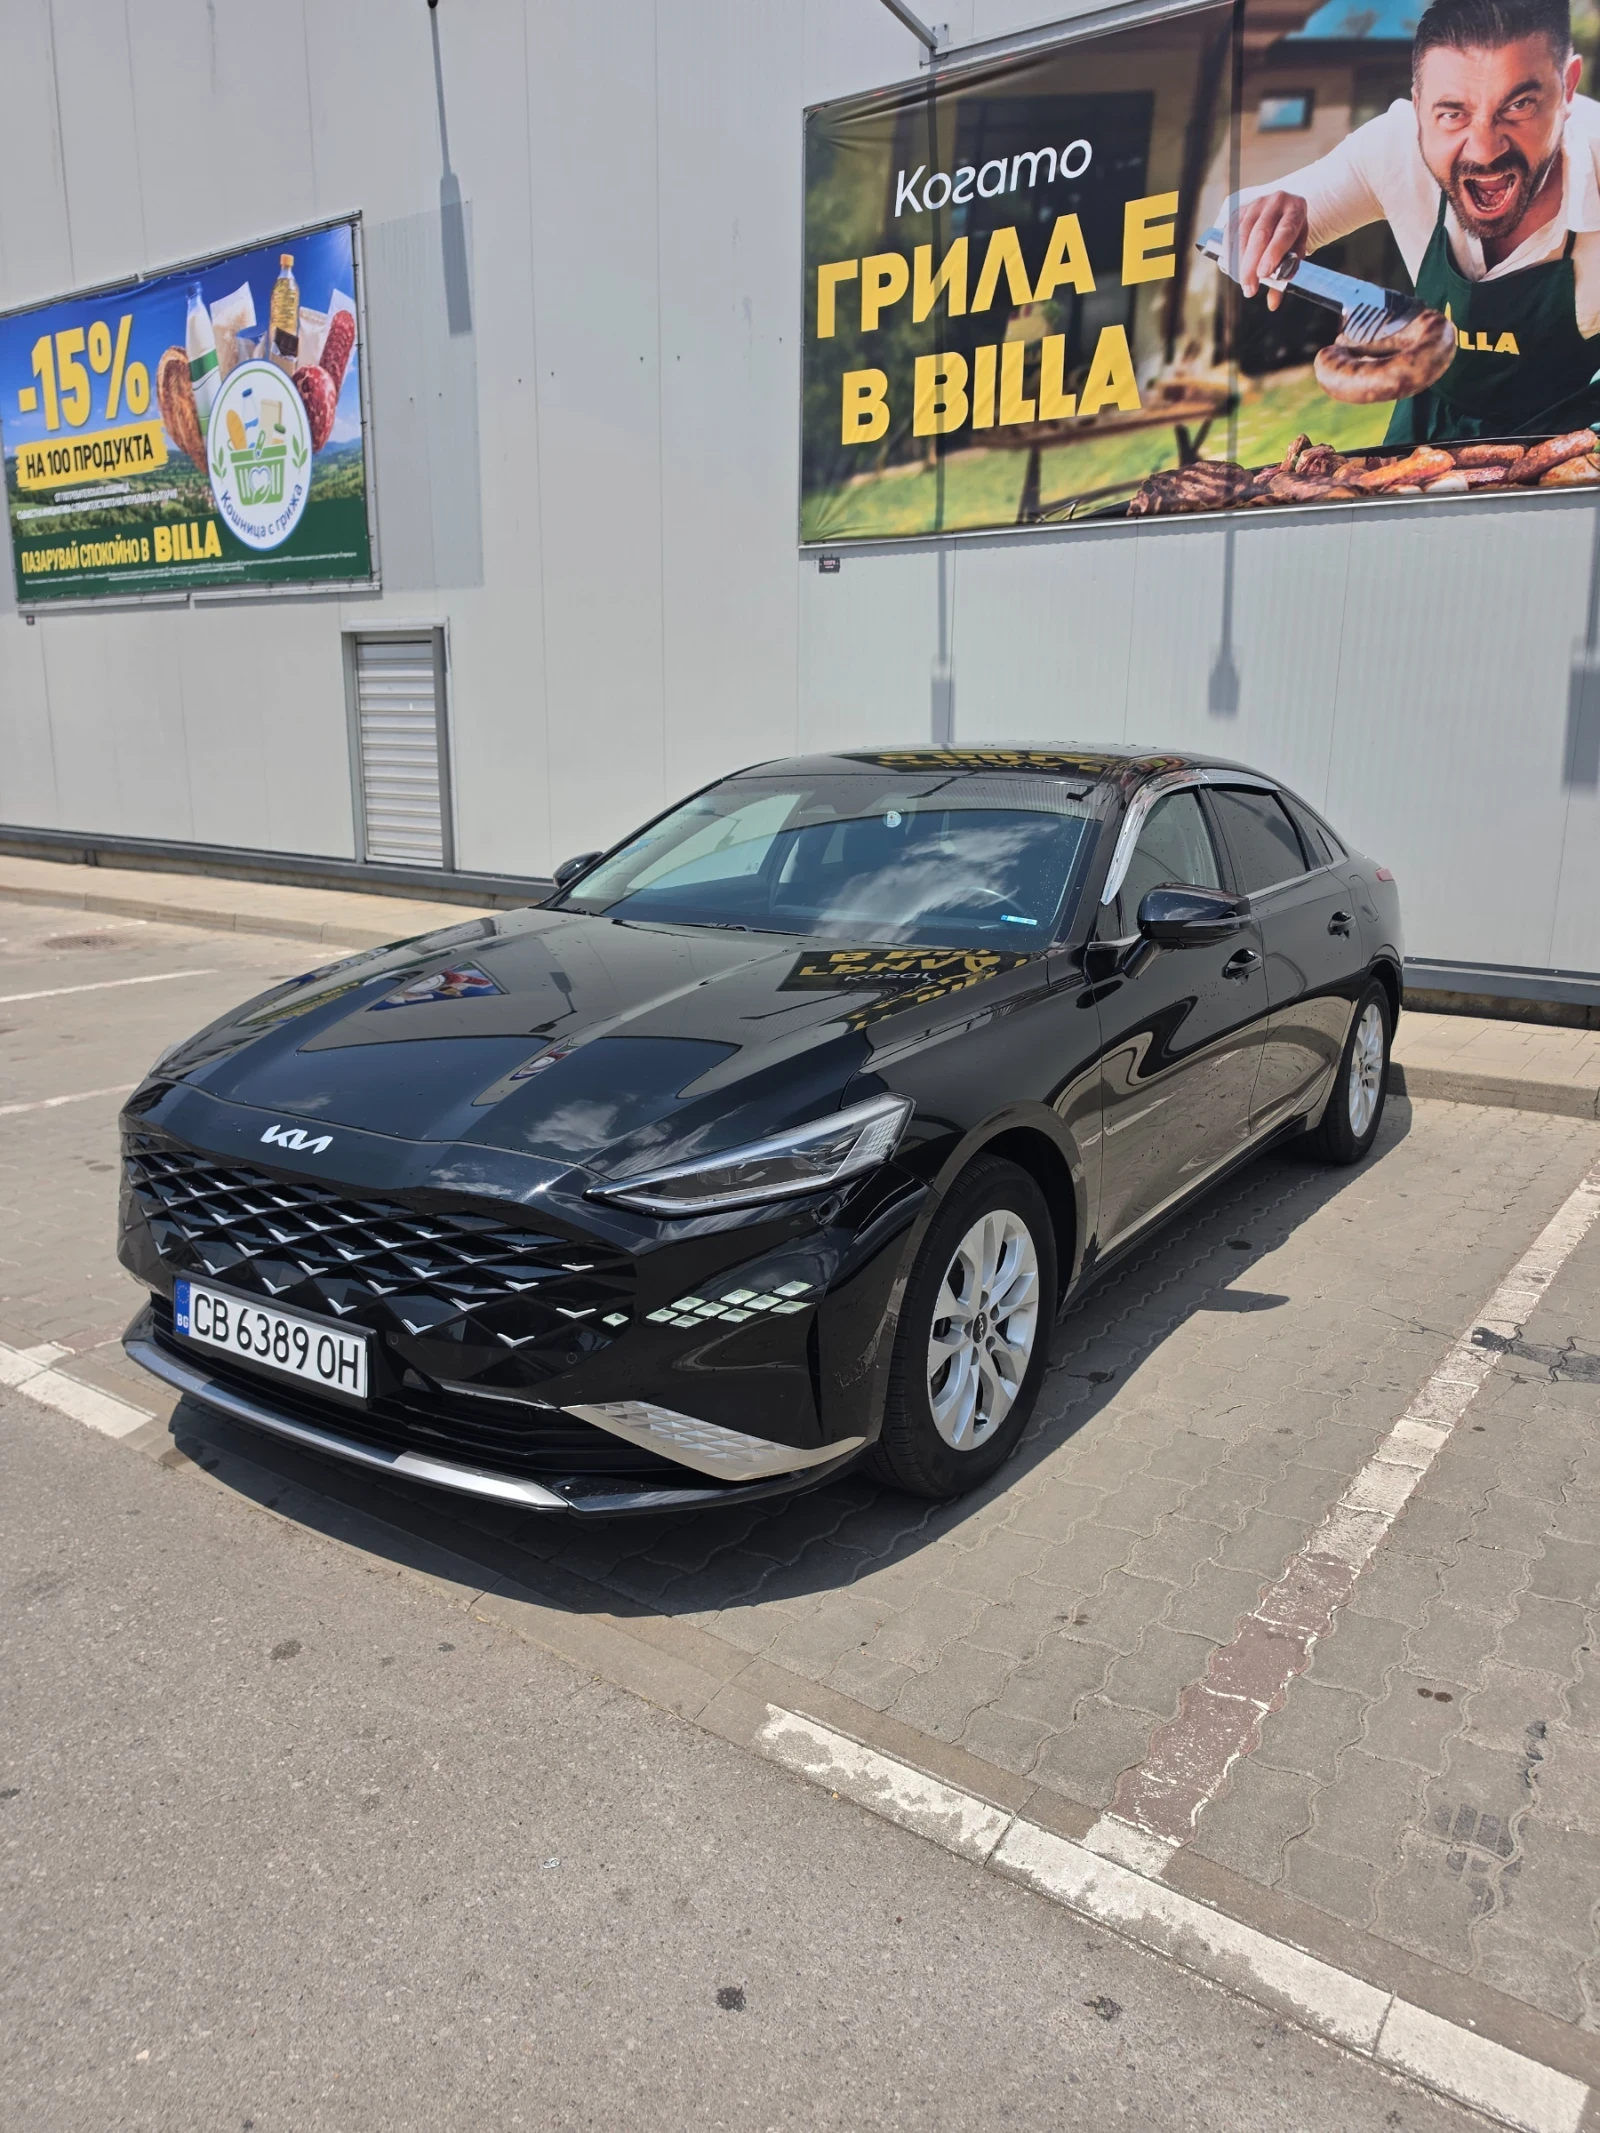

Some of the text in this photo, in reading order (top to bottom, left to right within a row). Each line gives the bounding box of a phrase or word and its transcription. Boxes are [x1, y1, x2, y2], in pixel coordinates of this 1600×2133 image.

[894, 138, 1093, 217] Когато
[817, 190, 1180, 339] ГРИЛА Е
[18, 313, 151, 432] -15%
[841, 323, 1142, 446] В BILLA
[25, 432, 155, 479] НА 100 ПРОДУКТА
[21, 540, 79, 574] ПАЗАРУВАЙ
[80, 533, 140, 569] СПОКОЙНО
[140, 537, 150, 564] В
[153, 520, 223, 563] BILLA
[260, 1124, 333, 1154] KIA
[176, 1312, 189, 1329] BG
[236, 1307, 310, 1370] 6389
